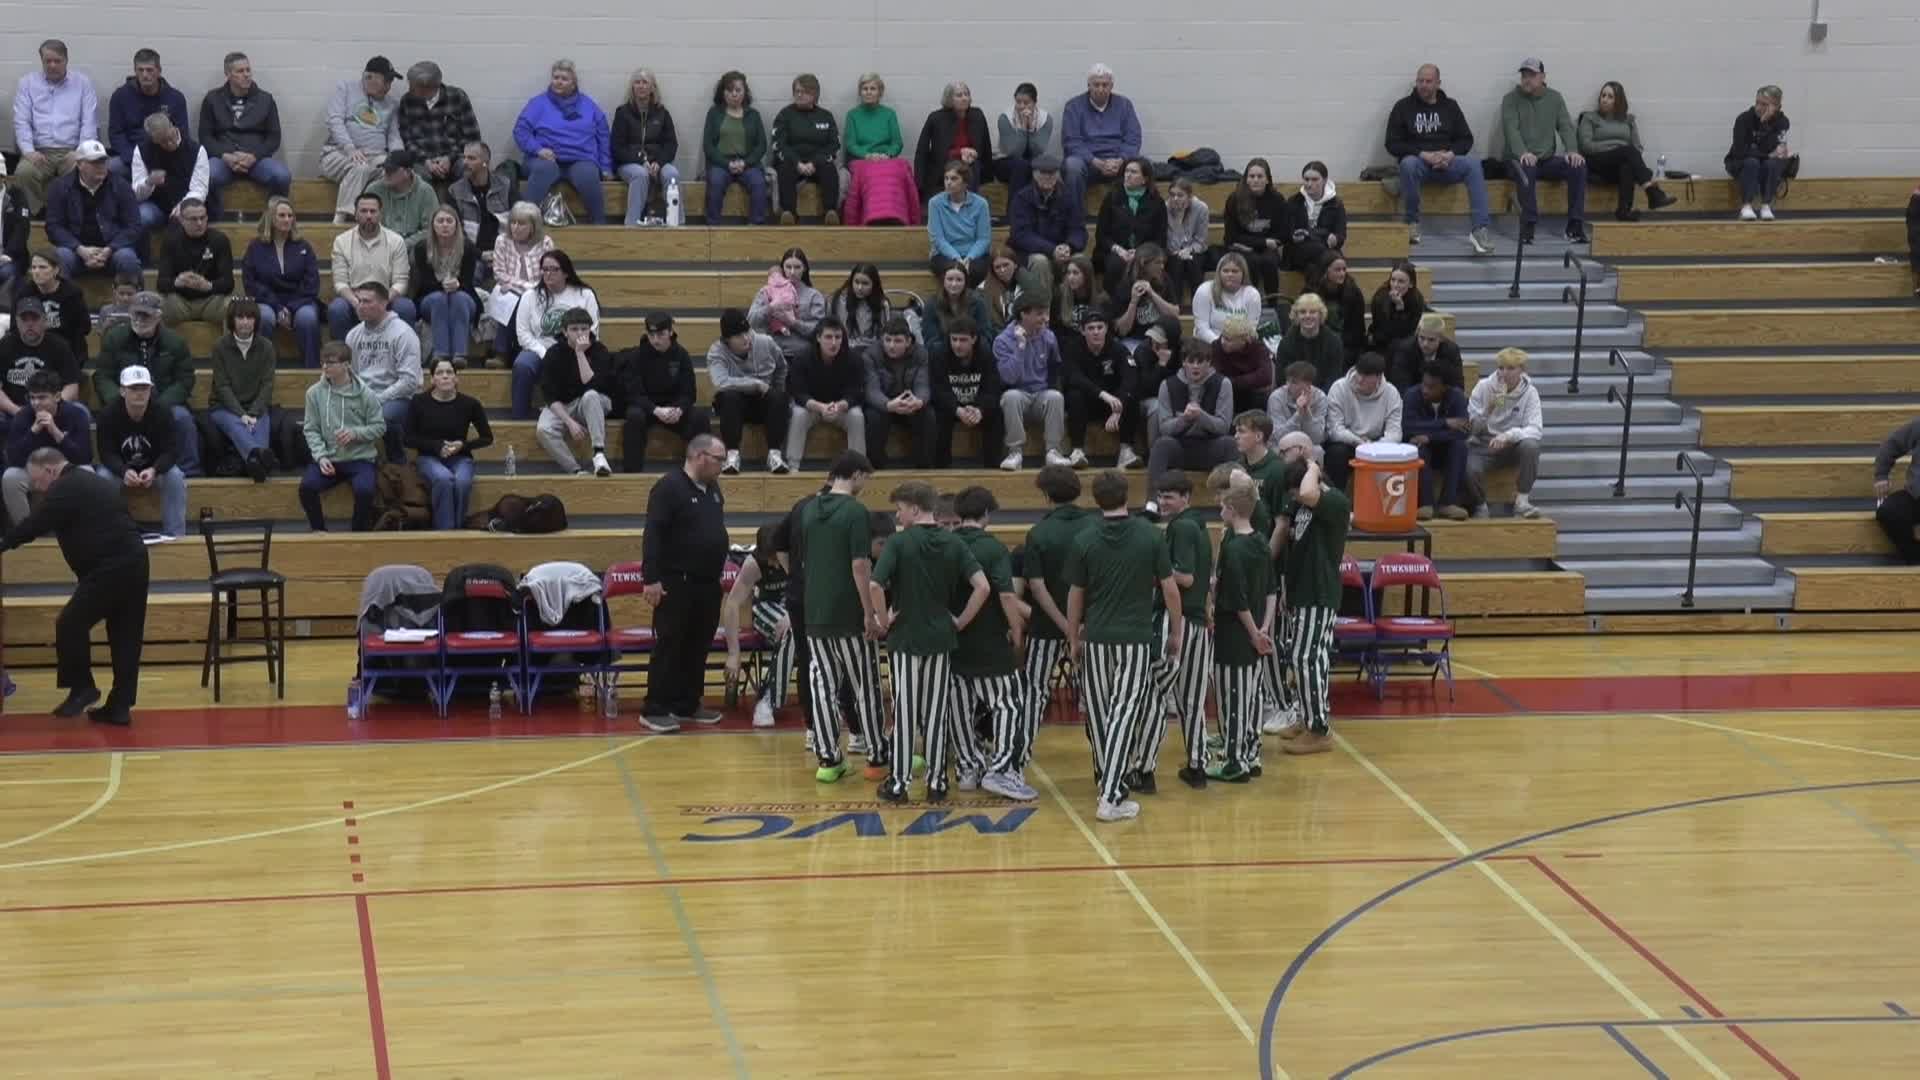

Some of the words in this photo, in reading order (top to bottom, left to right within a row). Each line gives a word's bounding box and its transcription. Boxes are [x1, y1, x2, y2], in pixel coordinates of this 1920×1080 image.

[1386, 475, 1405, 497] G
[1381, 564, 1430, 573] TEWKSBURY
[680, 806, 1040, 842] MVC
